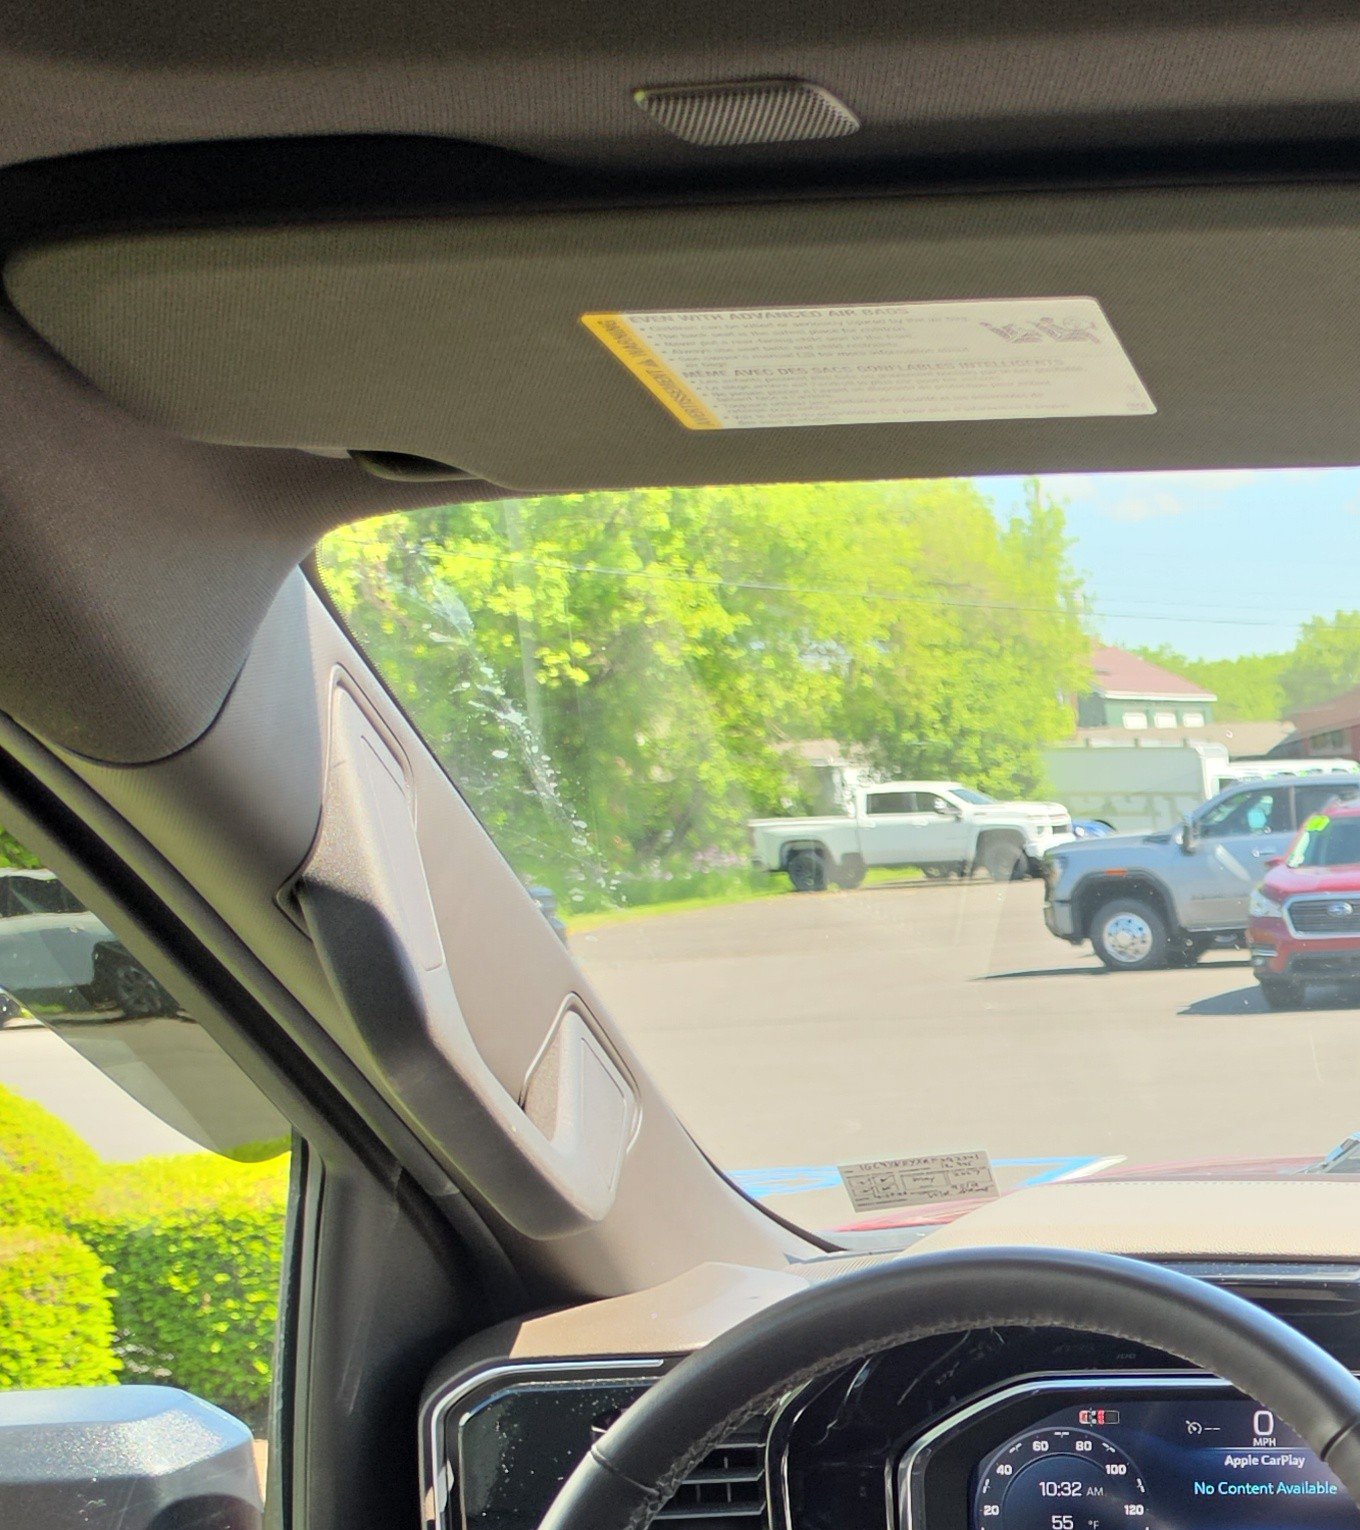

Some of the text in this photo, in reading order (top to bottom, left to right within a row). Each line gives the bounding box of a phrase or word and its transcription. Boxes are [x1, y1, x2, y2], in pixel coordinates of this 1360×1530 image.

[1253, 1410, 1274, 1436] 0
[1032, 1441, 1049, 1451] 60
[1075, 1441, 1092, 1451] 80
[1253, 1438, 1277, 1446] MPH
[1224, 1454, 1305, 1468] Apple CarPlay
[996, 1465, 1013, 1475] 40
[1105, 1464, 1127, 1475] 100
[1039, 1481, 1104, 1497] 10:32 AM
[1194, 1481, 1337, 1495] No Content Available
[983, 1505, 1000, 1516] 20
[1124, 1504, 1144, 1515] 120
[1051, 1515, 1074, 1530] 55
